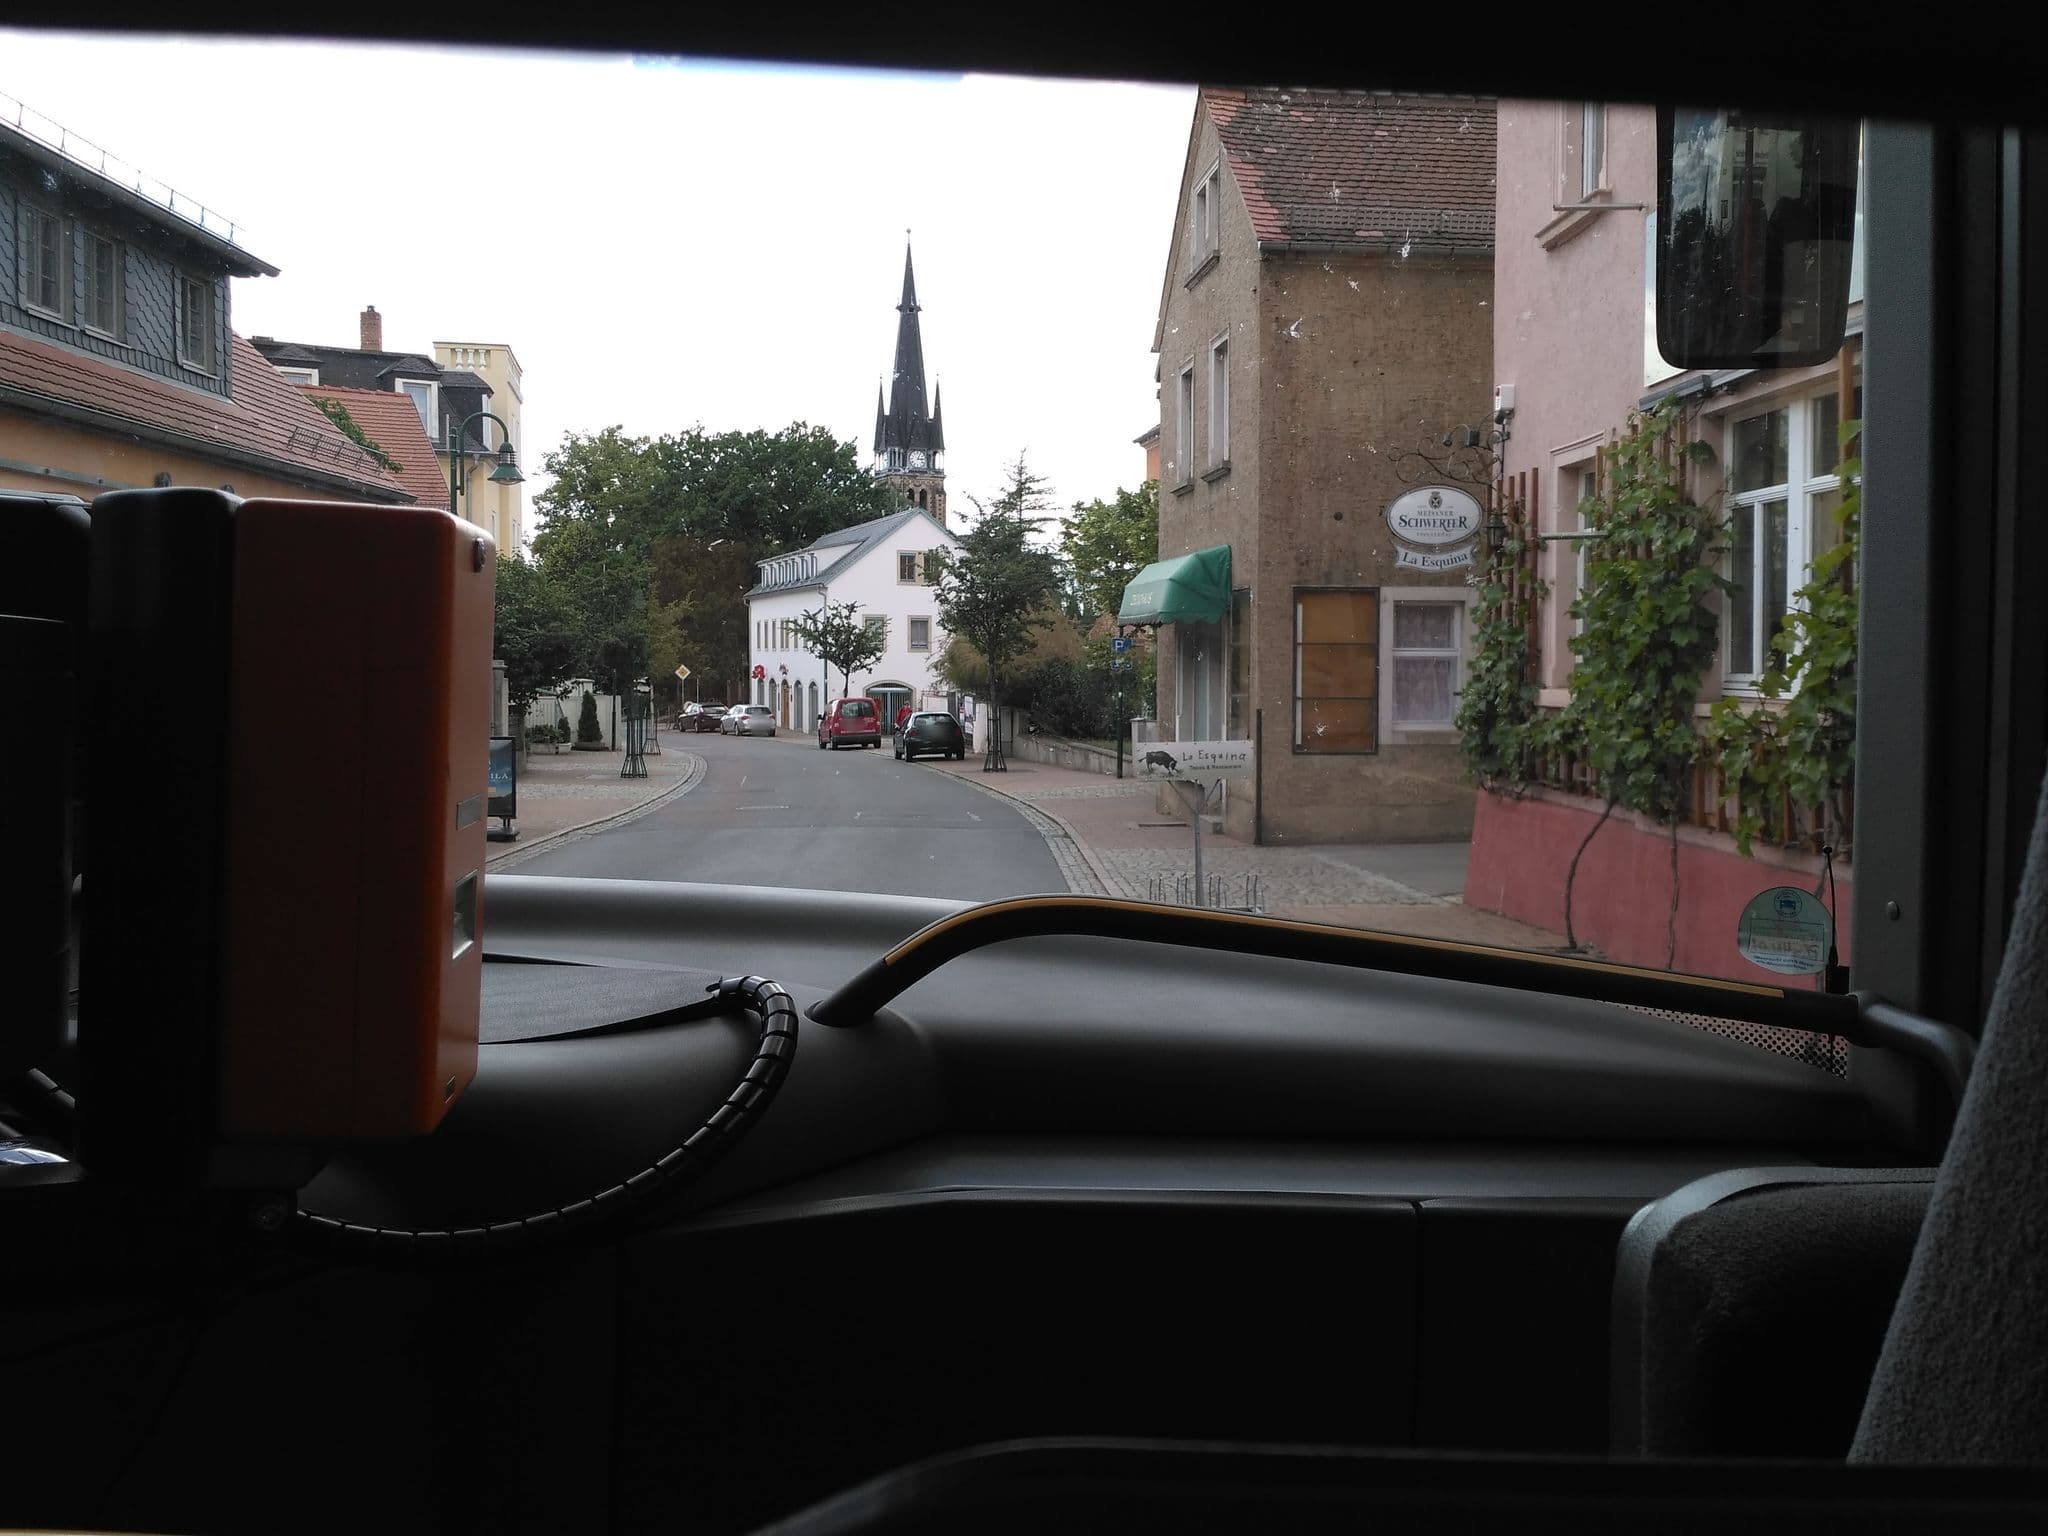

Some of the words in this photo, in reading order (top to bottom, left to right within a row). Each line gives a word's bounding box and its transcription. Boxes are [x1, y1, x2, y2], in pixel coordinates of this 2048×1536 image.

[1399, 515, 1468, 532] SCHWERTER
[1403, 552, 1417, 565] La
[1422, 553, 1468, 568] Esquina
[1198, 749, 1247, 763] Esquina
